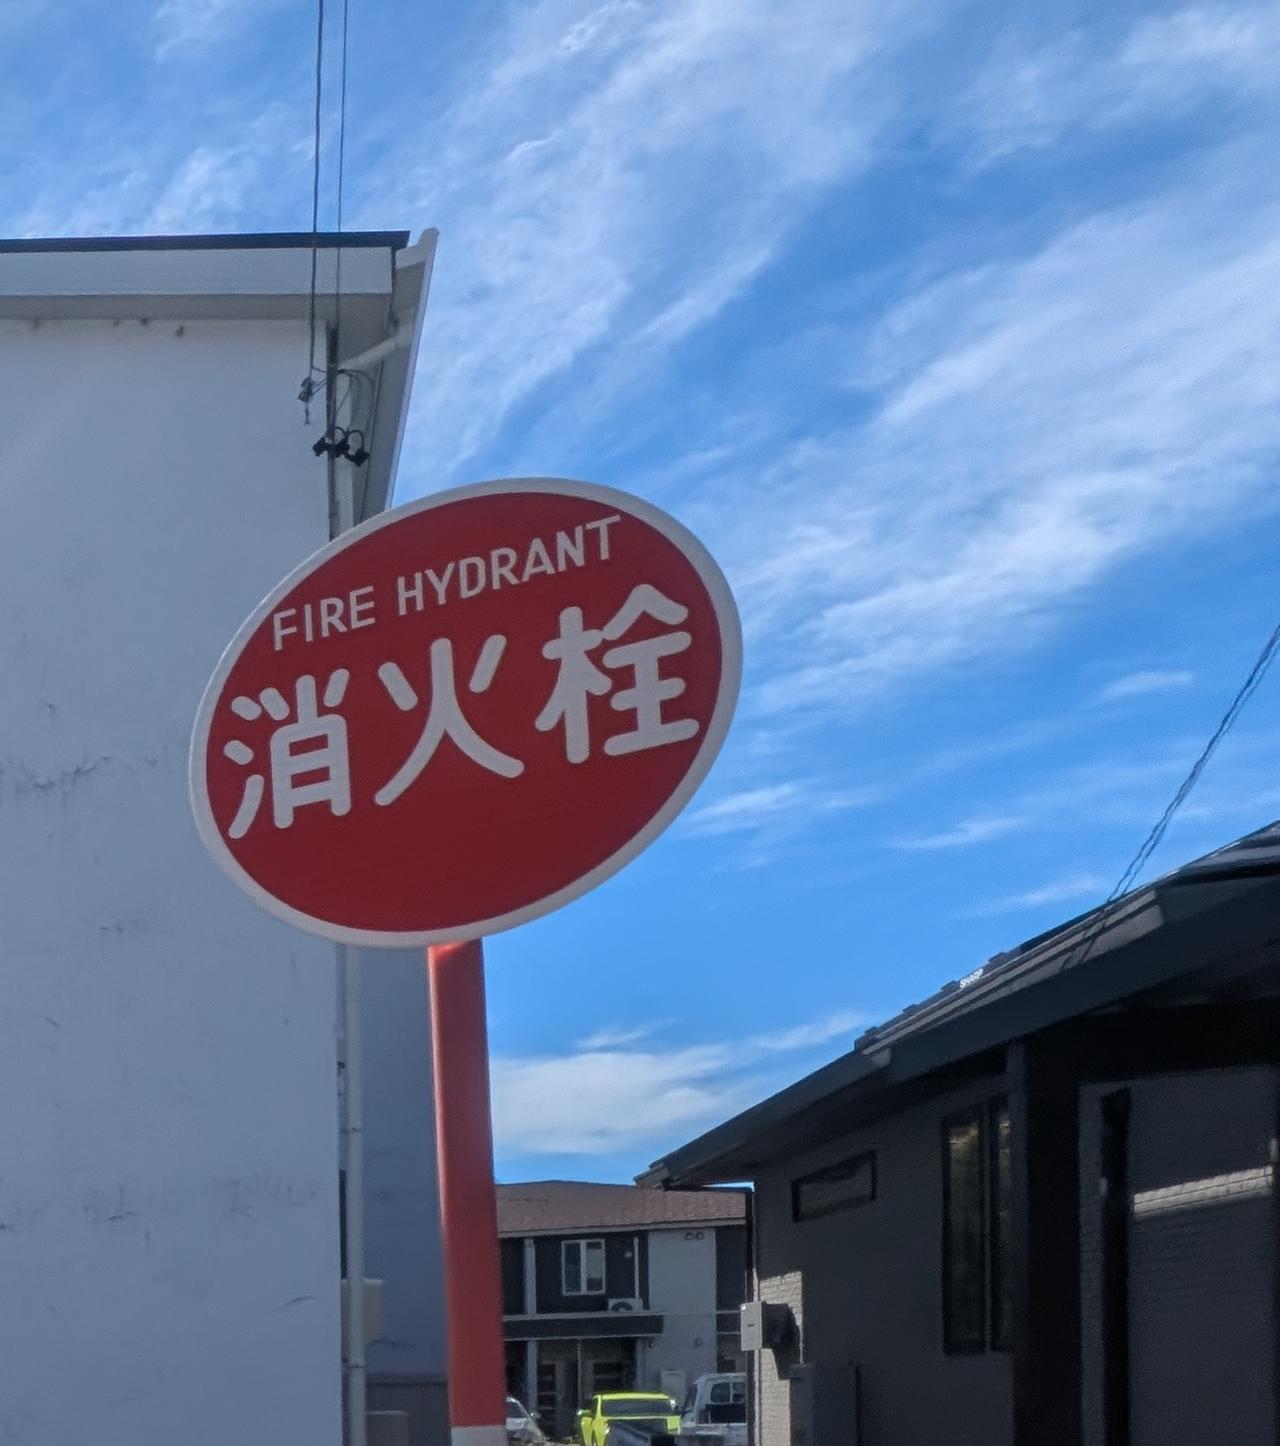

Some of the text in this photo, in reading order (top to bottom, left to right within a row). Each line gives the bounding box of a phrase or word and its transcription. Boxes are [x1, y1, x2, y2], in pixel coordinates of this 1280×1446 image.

[272, 514, 621, 651] FIRE HYDRANT
[223, 583, 700, 839] 消火栓
